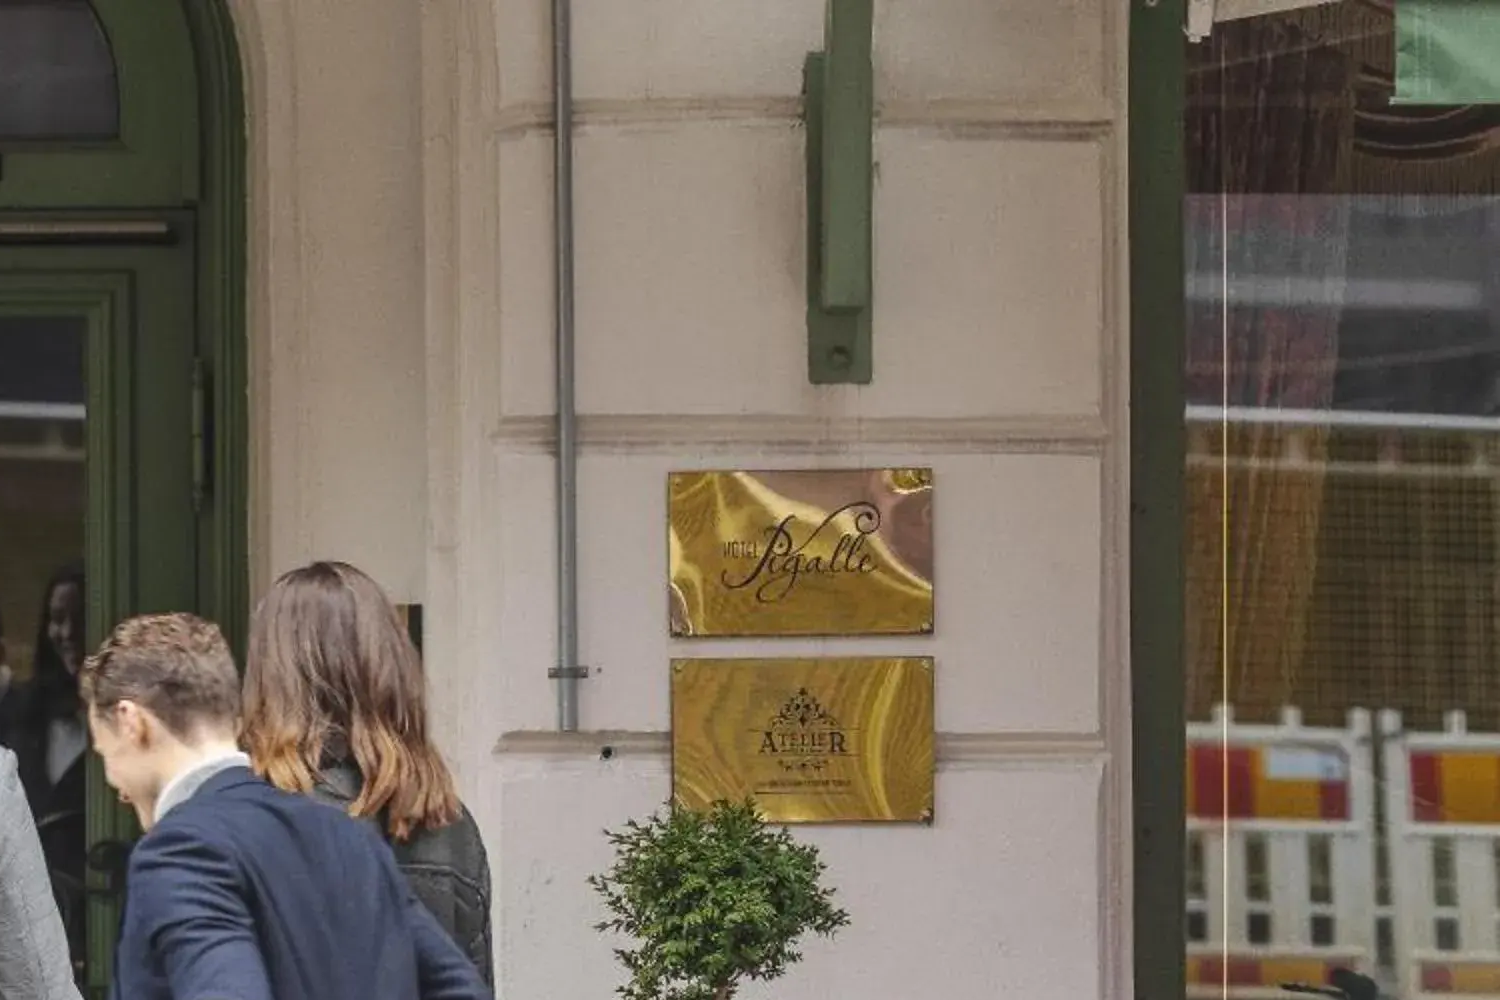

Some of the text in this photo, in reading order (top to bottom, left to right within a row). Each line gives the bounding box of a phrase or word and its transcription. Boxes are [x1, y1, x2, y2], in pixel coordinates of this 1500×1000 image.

[721, 501, 882, 603] HOTEL Pigalle
[759, 731, 847, 753] ATELIER
